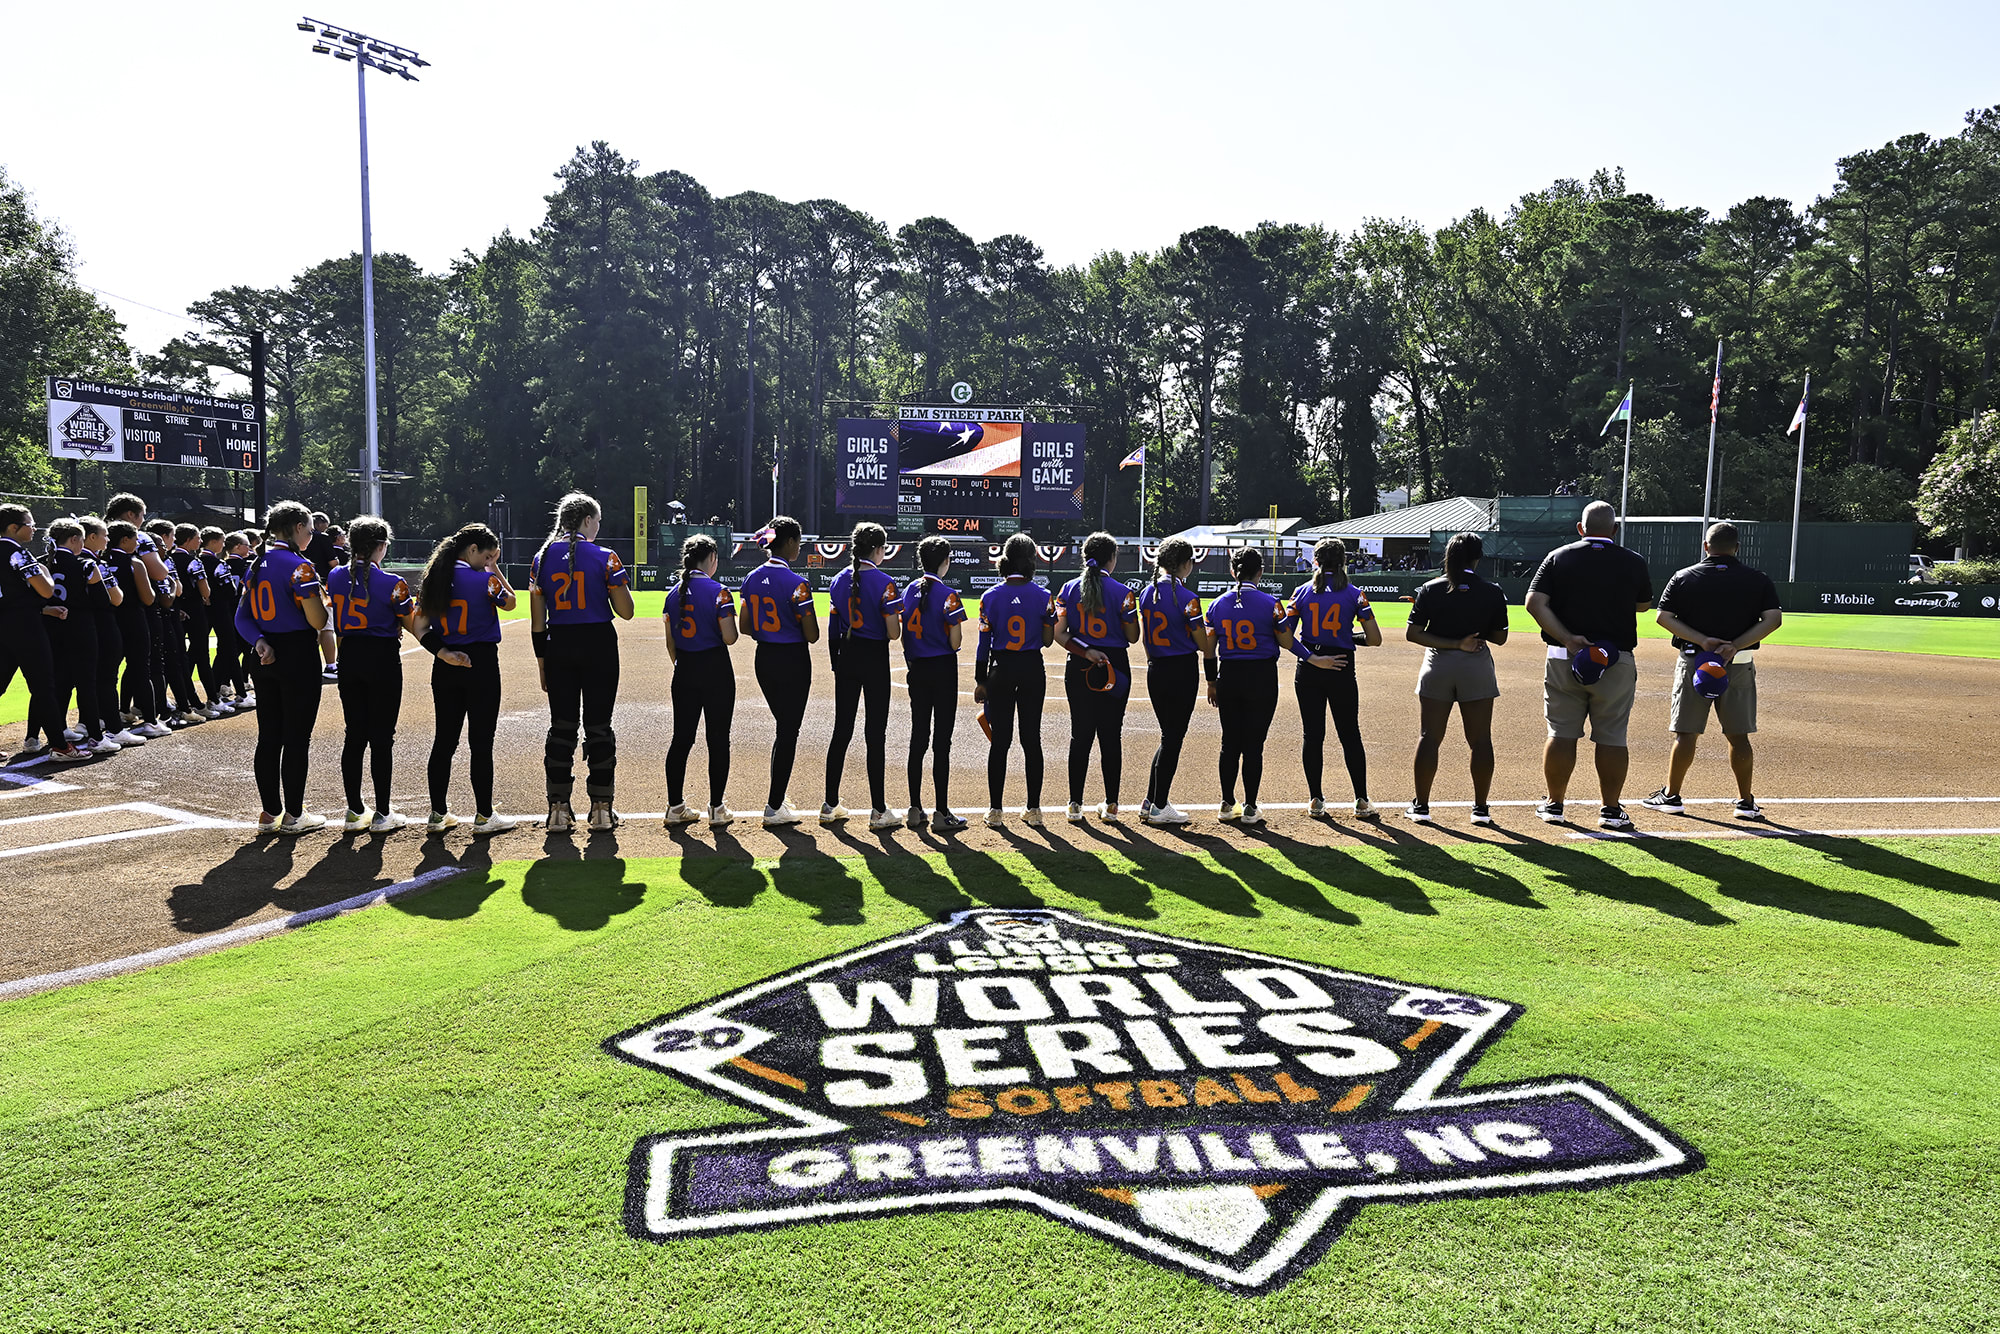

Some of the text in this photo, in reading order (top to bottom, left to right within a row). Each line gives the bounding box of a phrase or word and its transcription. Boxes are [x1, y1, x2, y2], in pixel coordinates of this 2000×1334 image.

[76, 382, 100, 393] Little
[104, 386, 139, 398] League
[184, 395, 212, 406] World
[214, 399, 240, 410] Series
[182, 405, 196, 414] NC
[901, 409, 1022, 422] ELM STREET PARK
[70, 420, 104, 432] WORLD
[134, 412, 217, 429] BALL STRIKE OUT
[70, 429, 104, 442] SERIES
[124, 428, 162, 444] VISITOR
[246, 425, 250, 433] E
[145, 444, 155, 461] 0
[226, 438, 257, 452] HOME
[847, 437, 888, 454] GIRLS
[1032, 442, 1074, 458] GIRLS
[180, 454, 208, 466] INNING
[243, 453, 252, 468] 0
[856, 454, 880, 464] with
[1041, 458, 1064, 468] with
[847, 464, 888, 480] GAME
[1032, 468, 1073, 484] GAME
[916, 477, 922, 488] 0
[952, 478, 958, 488] 0
[983, 479, 990, 490] 0
[1012, 498, 1018, 506] 0
[1012, 507, 1018, 516] 0
[937, 518, 979, 531] 9:52 AM
[552, 571, 585, 610] 21
[1127, 581, 1141, 590] DQ
[247, 580, 276, 622] 10
[1834, 594, 1875, 605] Mobile
[334, 594, 368, 632] 15
[681, 604, 697, 638] 5
[750, 594, 781, 632] 13
[1077, 602, 1107, 639] 16
[1309, 602, 1342, 638] 14
[907, 607, 923, 639] 4
[1144, 608, 1171, 647] 12
[1006, 615, 1026, 651] 9
[1222, 619, 1257, 650] 18
[914, 953, 1180, 972] League
[806, 967, 1335, 1030] WORLD
[653, 1026, 745, 1053] 20
[821, 1011, 1401, 1108] SERIES
[946, 1071, 1320, 1120] SOFTBALL
[767, 1120, 1553, 1189] GREENVILLE, NC
